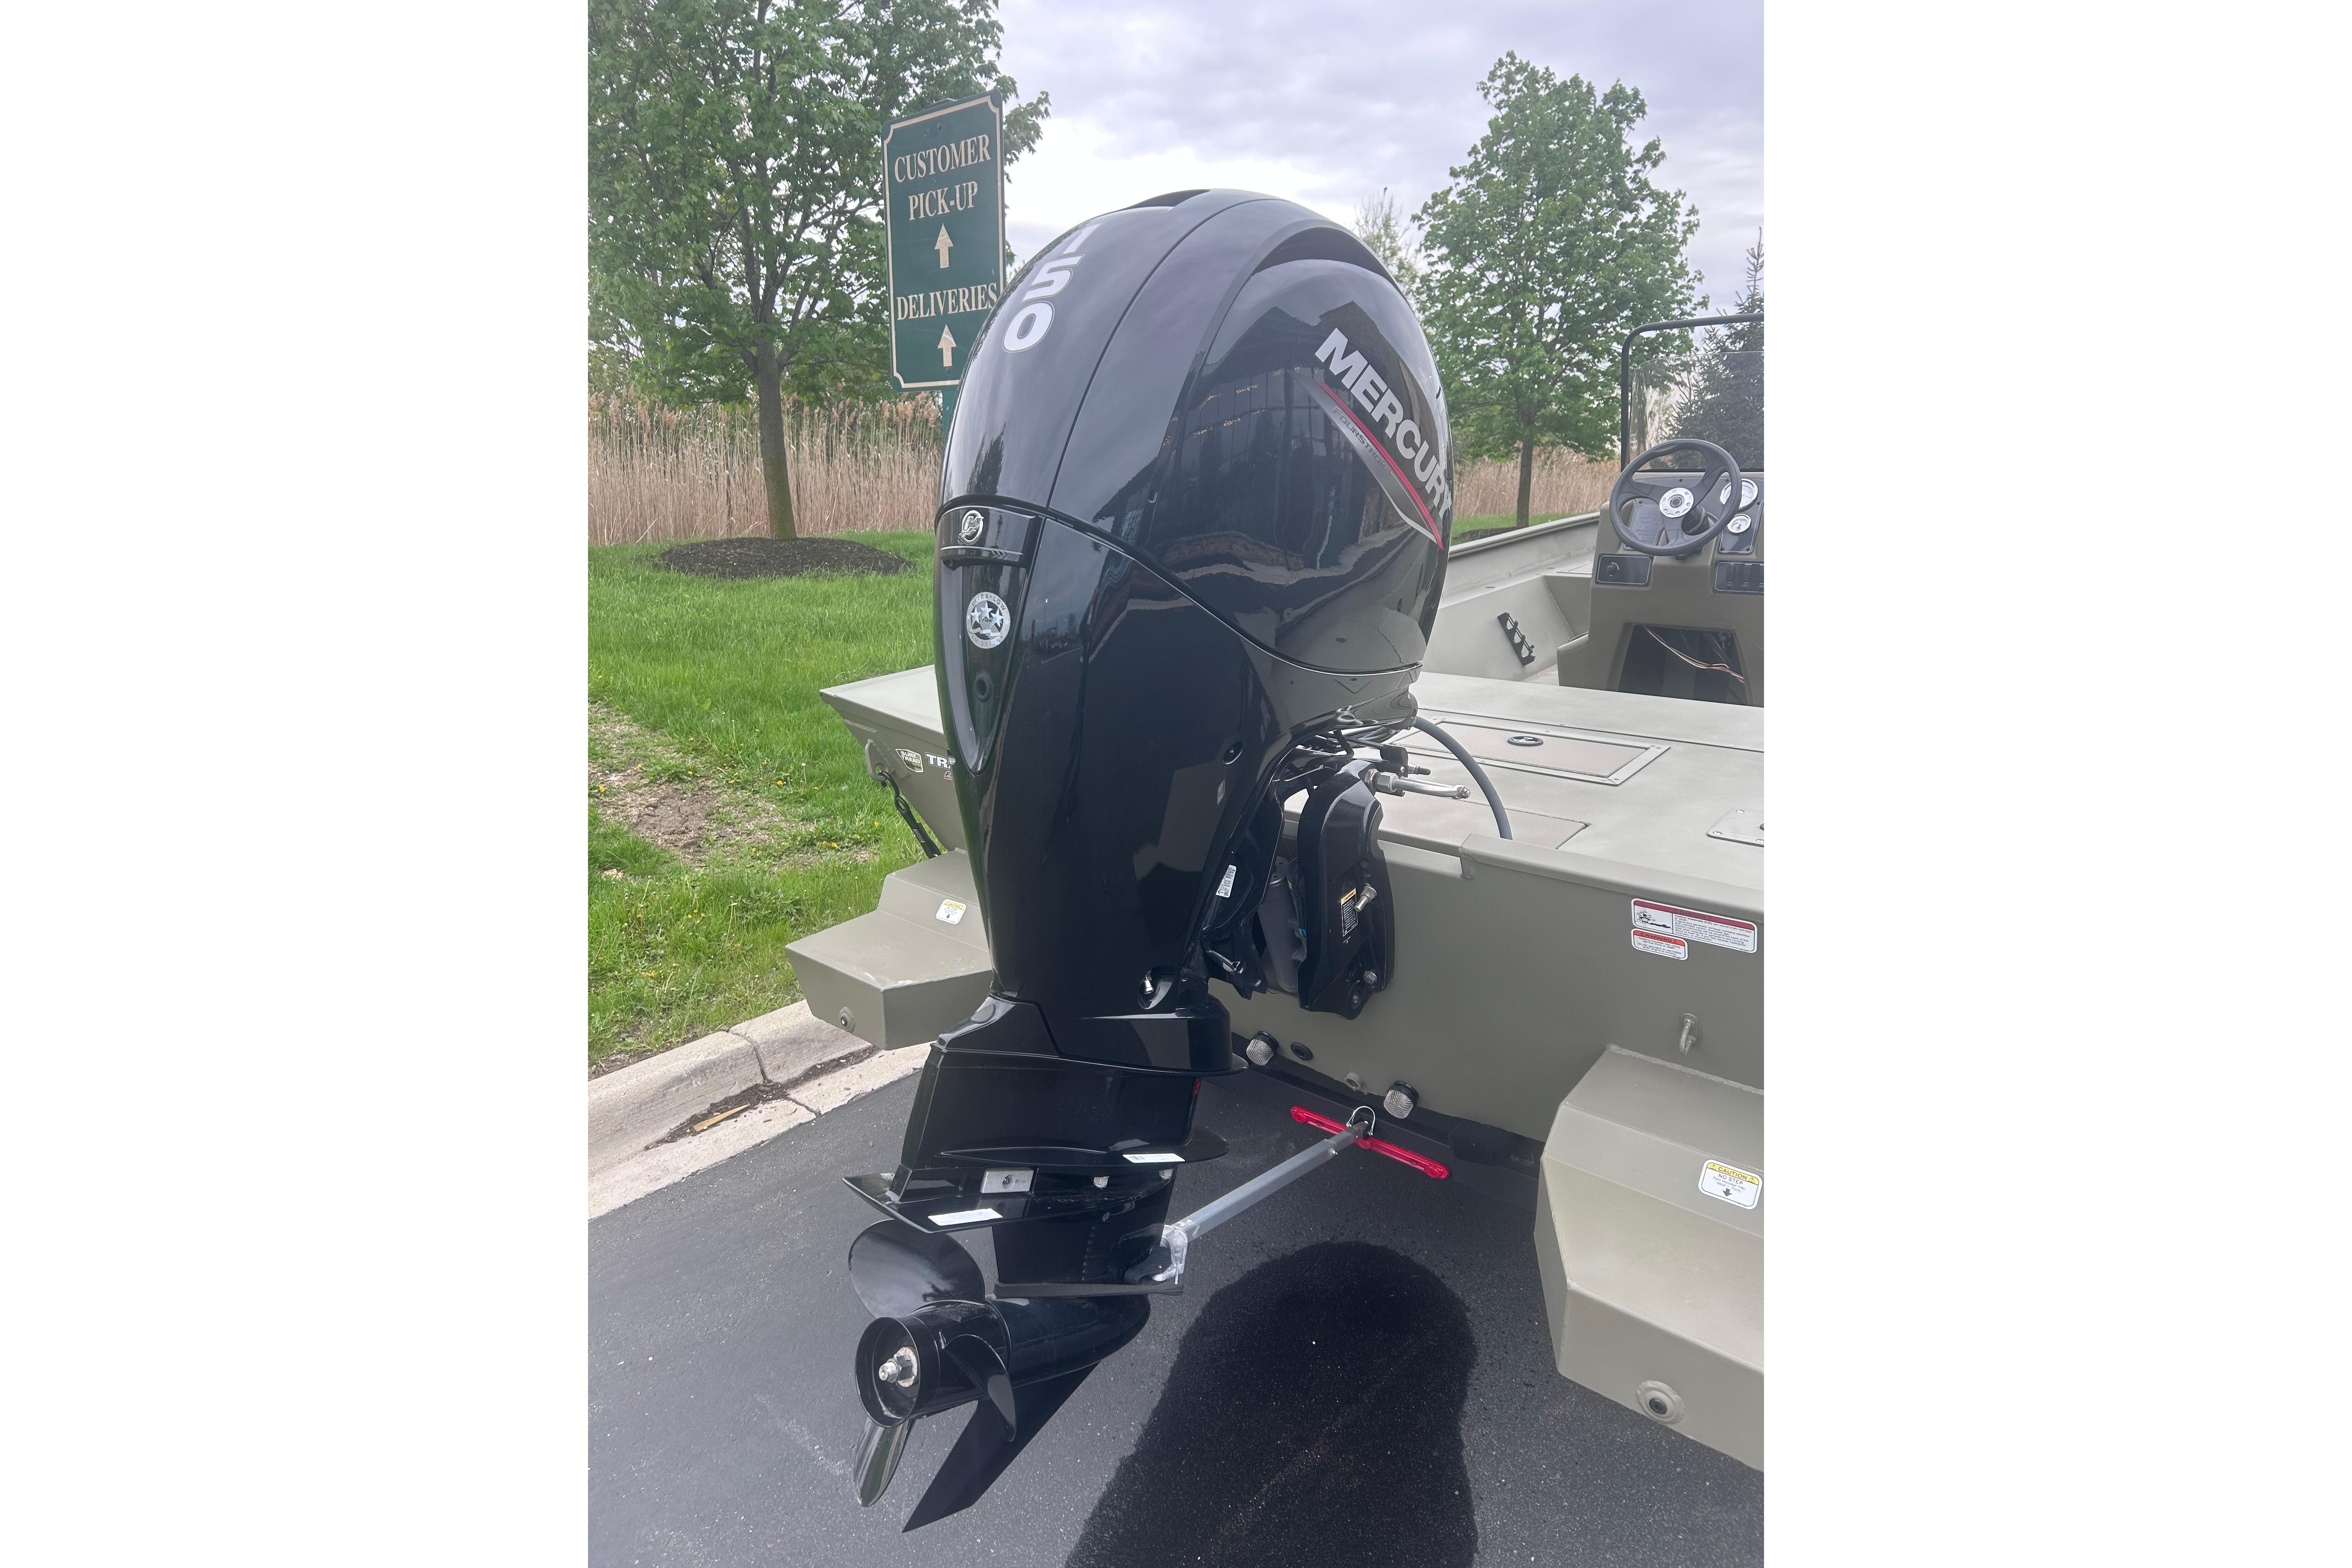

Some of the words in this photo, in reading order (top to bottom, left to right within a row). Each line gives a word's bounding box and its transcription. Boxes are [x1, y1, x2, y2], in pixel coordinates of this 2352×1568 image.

[894, 134, 992, 183] CUSTOMER
[908, 181, 978, 220] PICK-UP
[896, 282, 997, 321] DELIVERIES
[1003, 224, 1101, 353] 150
[1315, 327, 1452, 519] MERCURY
[1333, 406, 1390, 474] FOURSTROKE
[971, 593, 988, 606] ULTRA
[993, 597, 1006, 610] LOW
[901, 751, 917, 759] SURE
[901, 755, 920, 764] TREAD
[1645, 934, 1671, 942] WARNING
[1718, 1167, 1747, 1180] CAUTION
